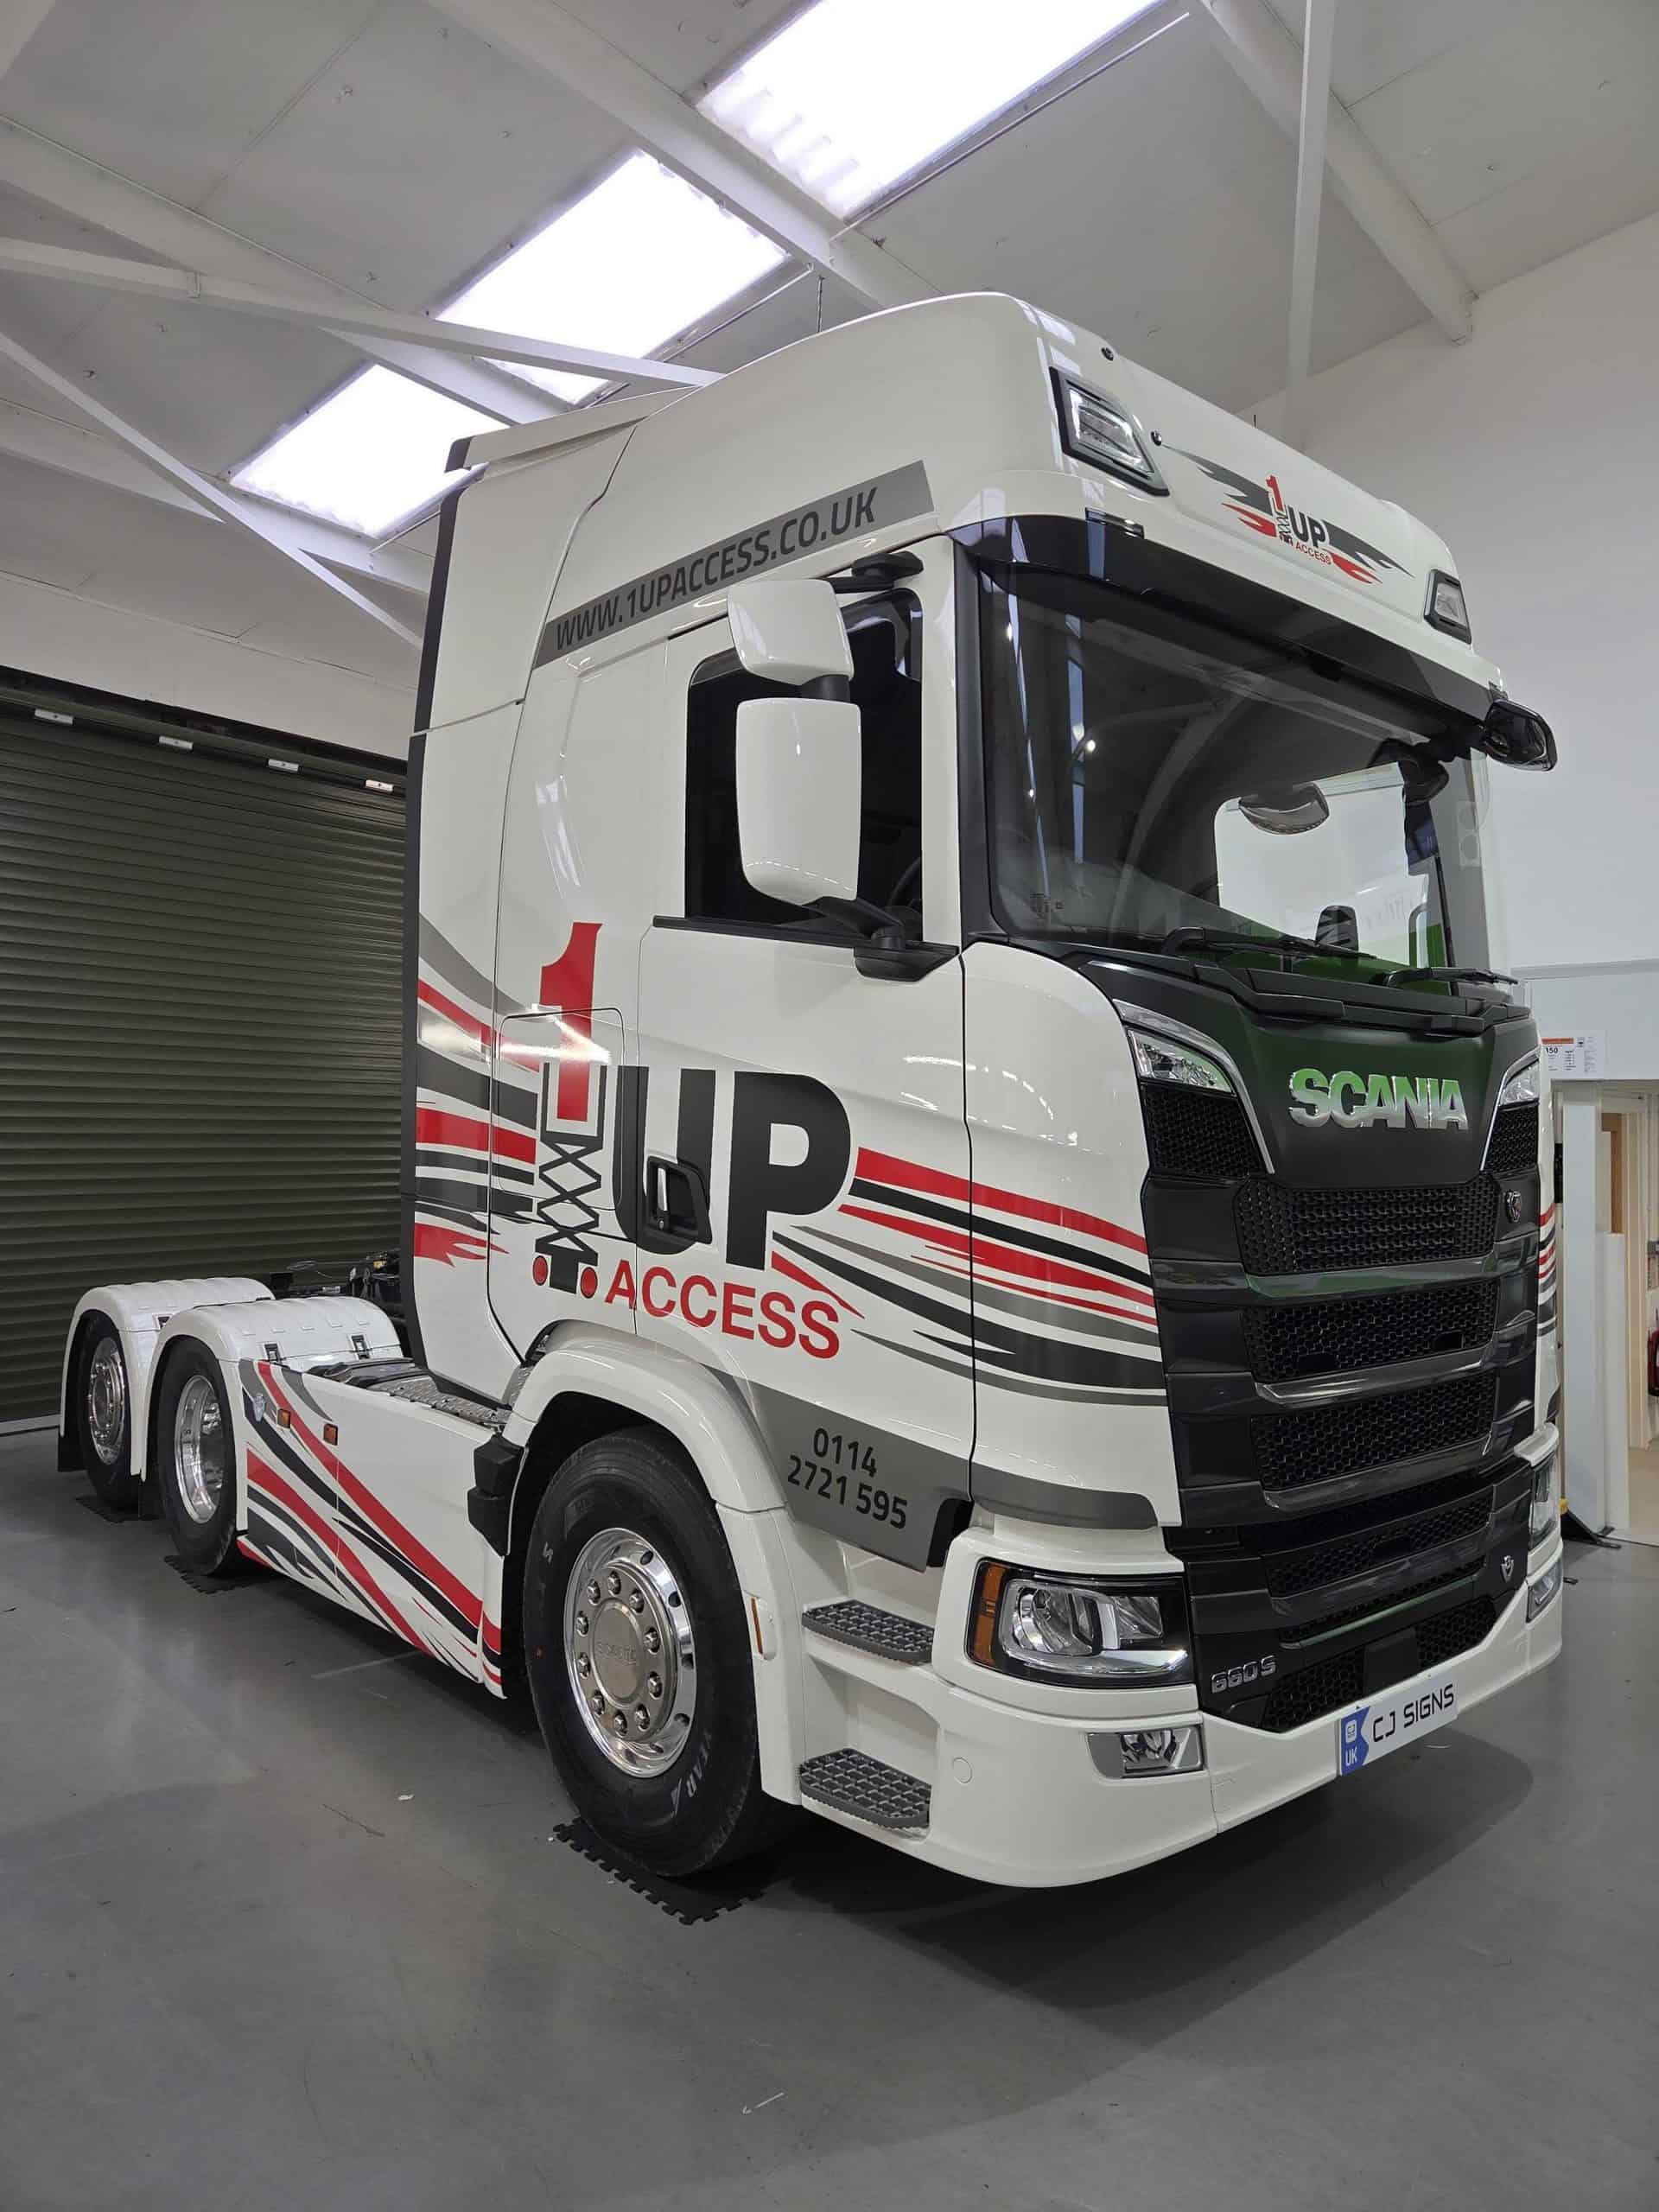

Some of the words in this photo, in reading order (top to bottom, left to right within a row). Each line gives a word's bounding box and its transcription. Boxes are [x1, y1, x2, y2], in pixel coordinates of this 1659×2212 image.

[1287, 505, 1326, 548] UP
[1295, 541, 1332, 565] ACCESS
[556, 486, 877, 651] WWW.1UPACCESS.CO.UK
[1288, 1068, 1469, 1131] SCANIA
[612, 1065, 851, 1271] UP
[605, 1259, 841, 1359] ACCESS
[813, 1427, 878, 1478] 0114
[787, 1454, 848, 1505] 2721
[855, 1483, 907, 1529] 595
[1372, 1710, 1396, 1743] CJ
[1403, 1683, 1455, 1729] SIGNS
[1345, 1745, 1357, 1766] UK
